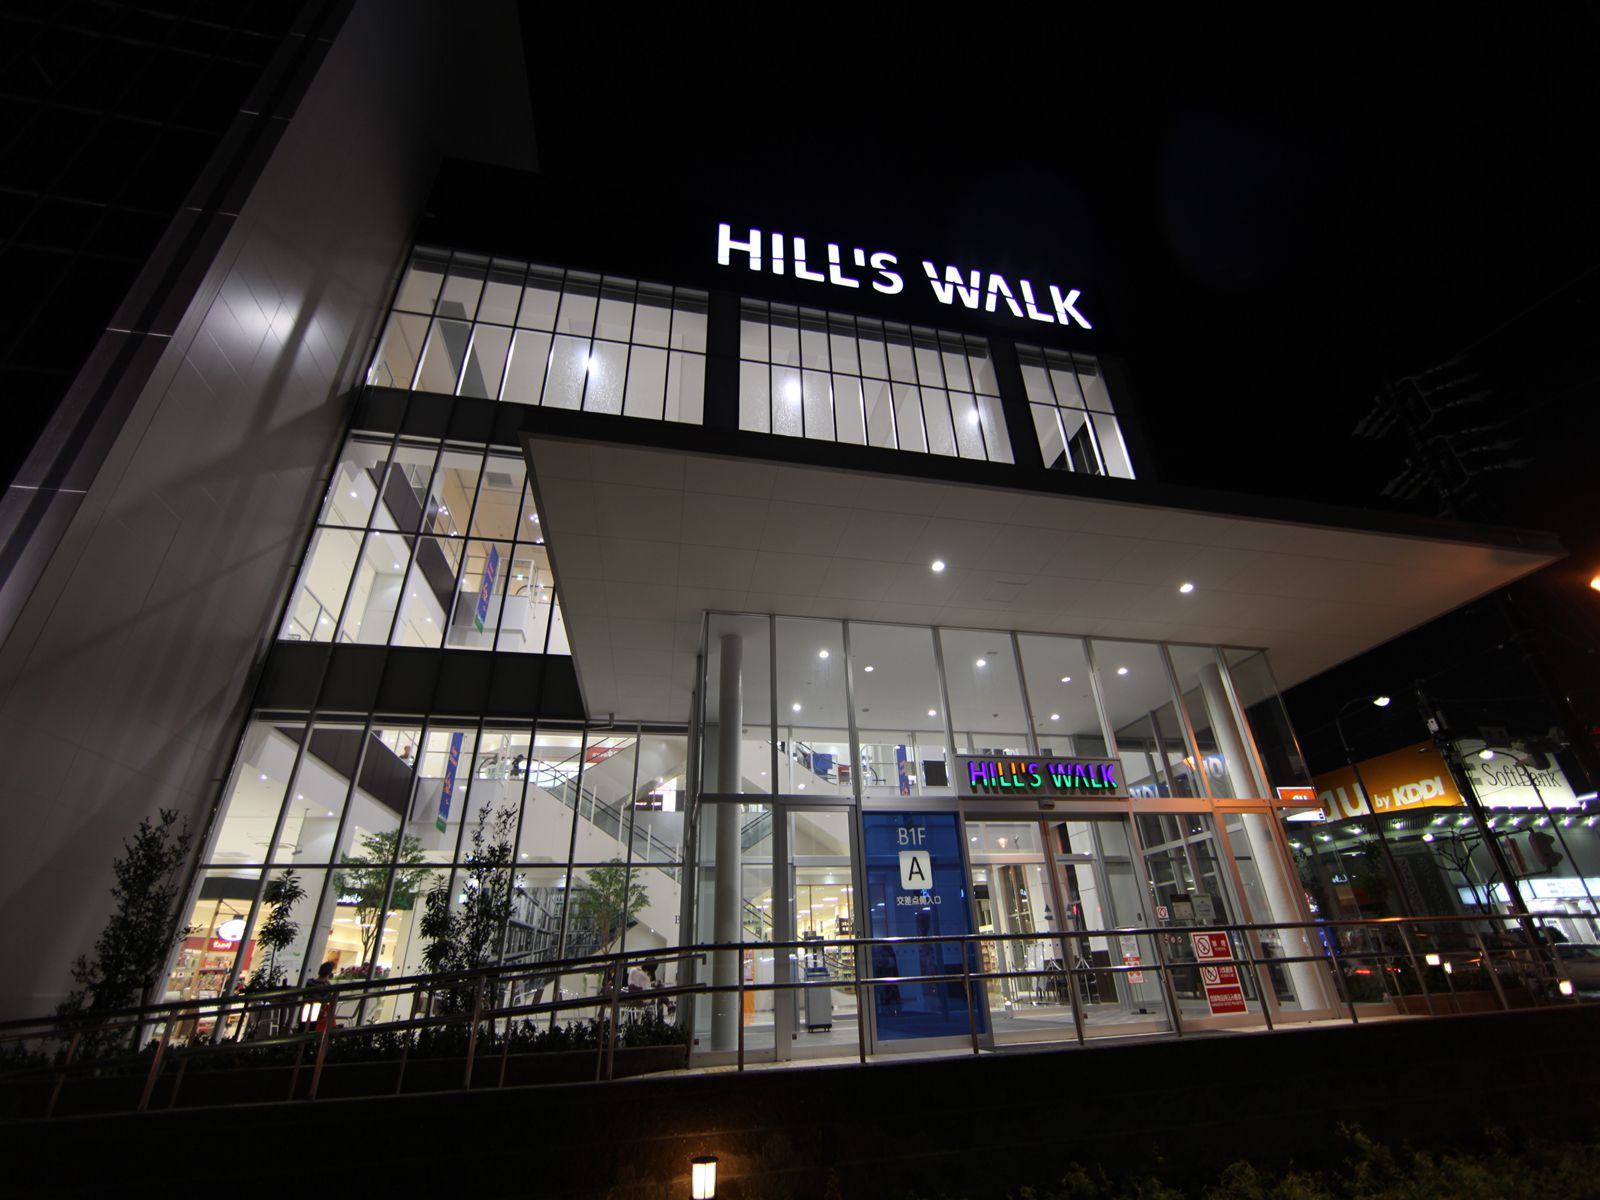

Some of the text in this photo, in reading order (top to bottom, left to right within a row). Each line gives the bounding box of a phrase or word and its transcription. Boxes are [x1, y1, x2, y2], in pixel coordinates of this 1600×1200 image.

[717, 222, 1093, 330] HILL'S WALK
[967, 760, 1119, 789] HILL'S WALK
[1481, 763, 1562, 787] SoftBank
[1374, 793, 1390, 810] by
[1391, 776, 1445, 807] KDDI
[898, 827, 926, 846] B1F
[908, 856, 925, 881] A
